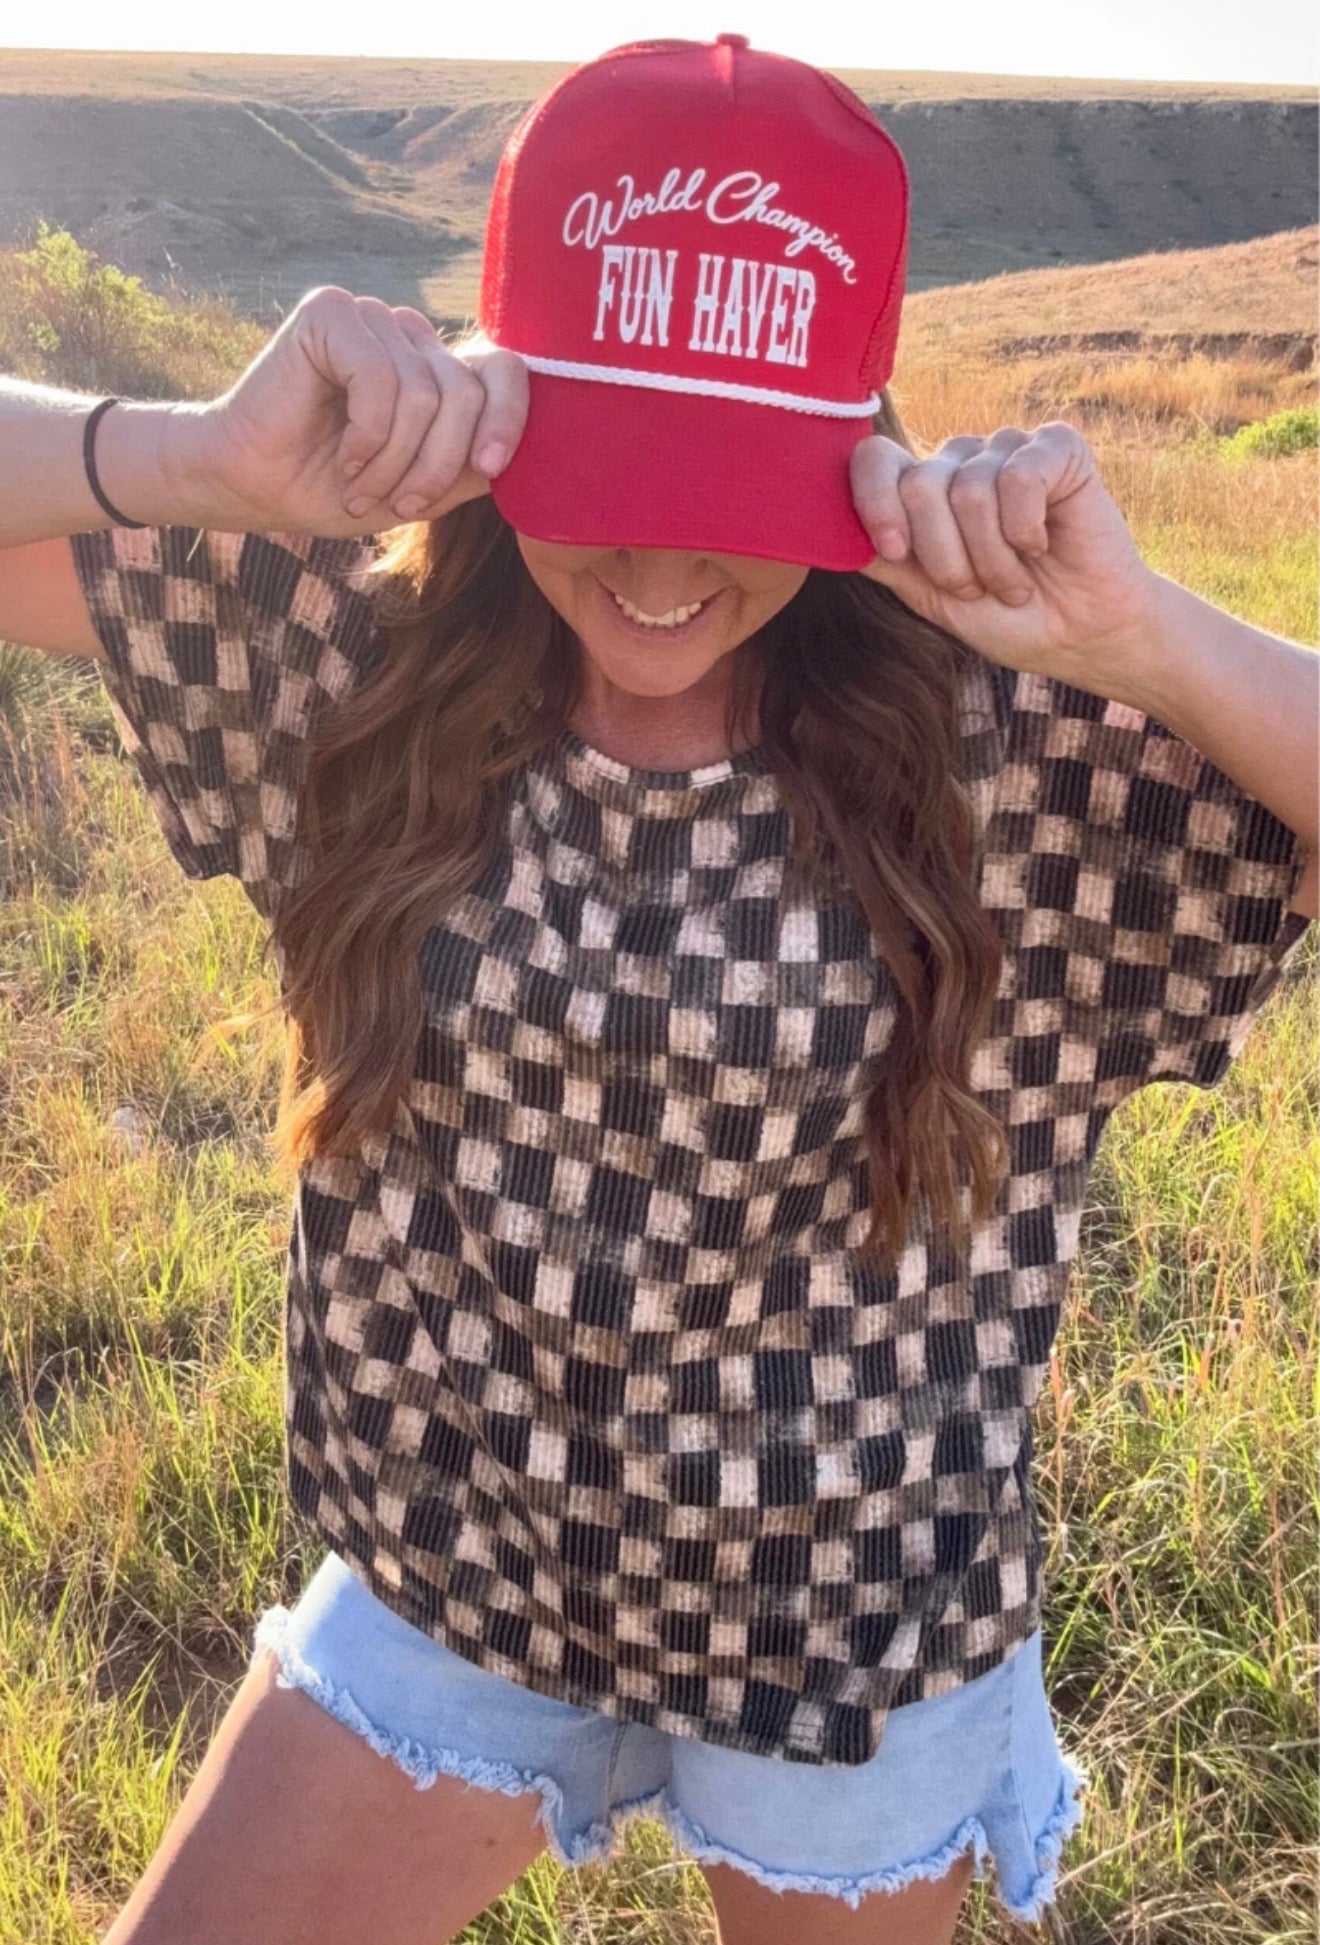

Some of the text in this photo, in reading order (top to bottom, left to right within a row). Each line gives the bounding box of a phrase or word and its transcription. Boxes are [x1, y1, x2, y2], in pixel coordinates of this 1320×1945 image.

[562, 167, 857, 285] World Champion
[593, 244, 816, 368] FUN HAVER
